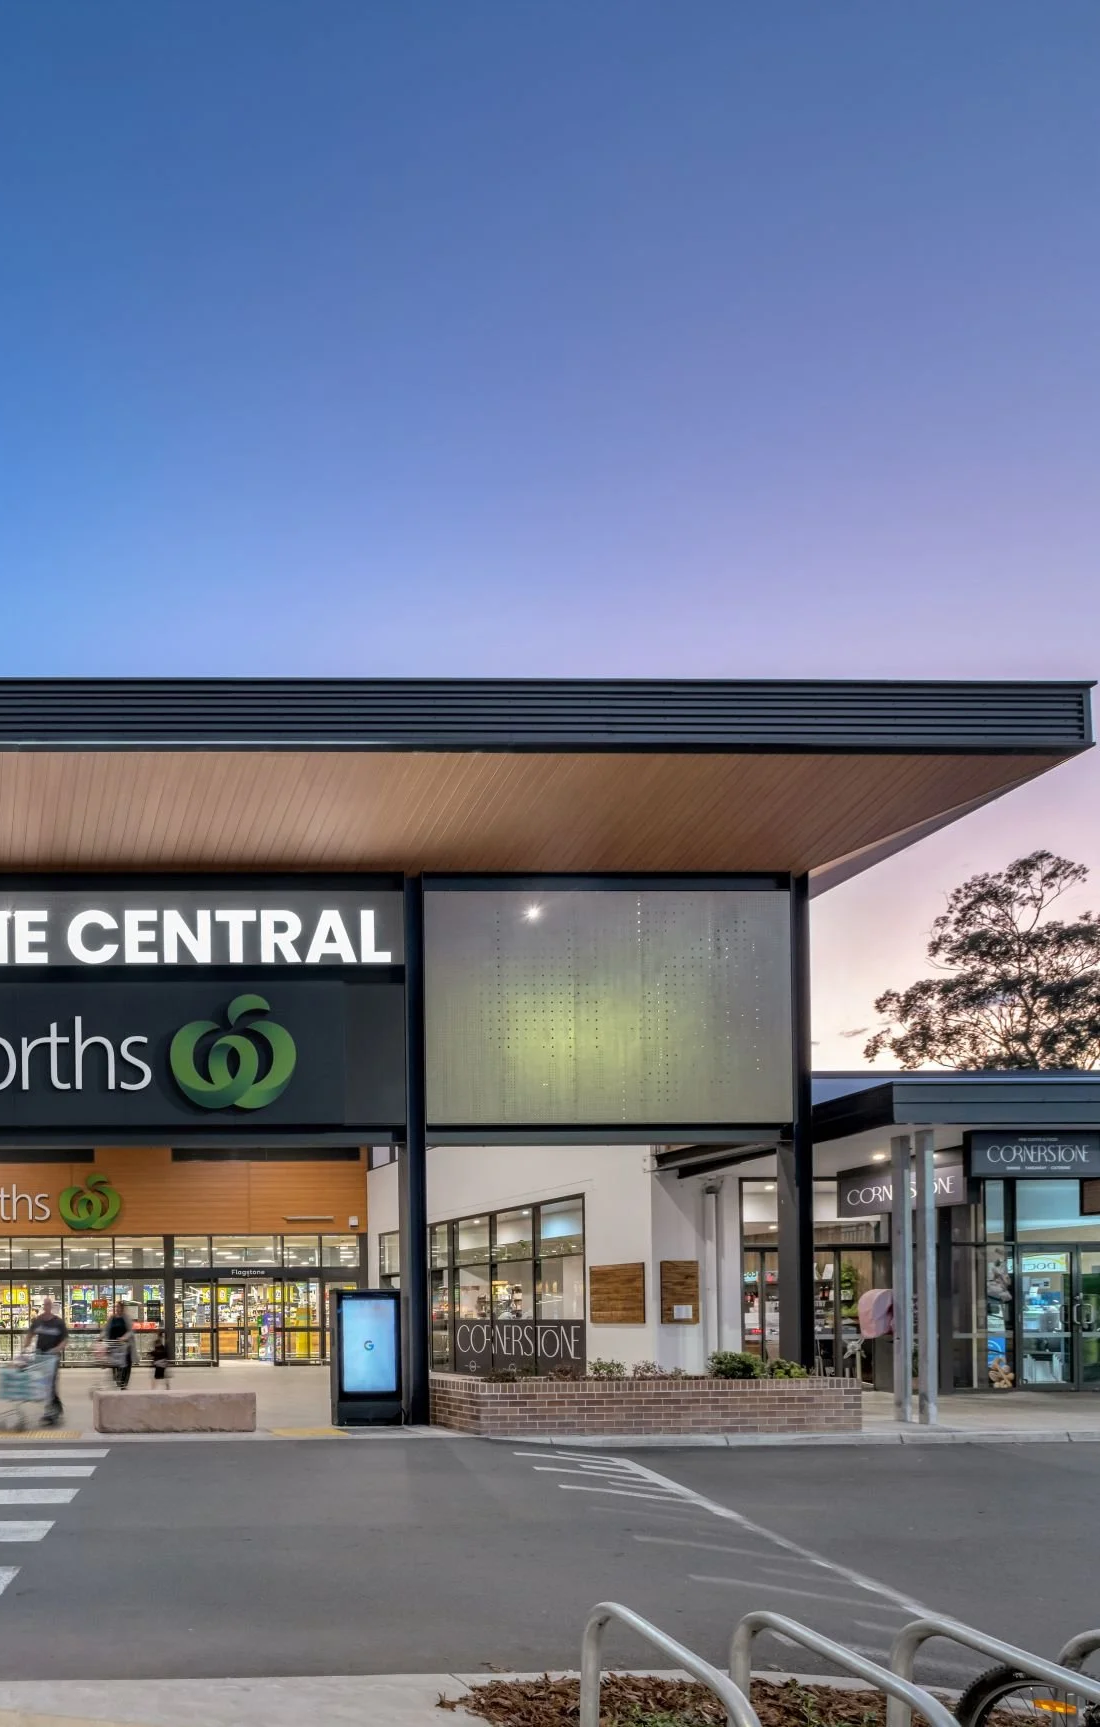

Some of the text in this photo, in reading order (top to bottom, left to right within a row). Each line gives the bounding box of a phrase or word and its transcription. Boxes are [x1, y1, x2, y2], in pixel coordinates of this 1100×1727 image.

[67, 909, 391, 965] CENTRAL
[986, 1145, 1089, 1163] CORNERSTONE
[847, 1176, 956, 1206] CORNSNE
[231, 1269, 266, 1278] Flagstone
[457, 1324, 581, 1360] CORNERSTONE
